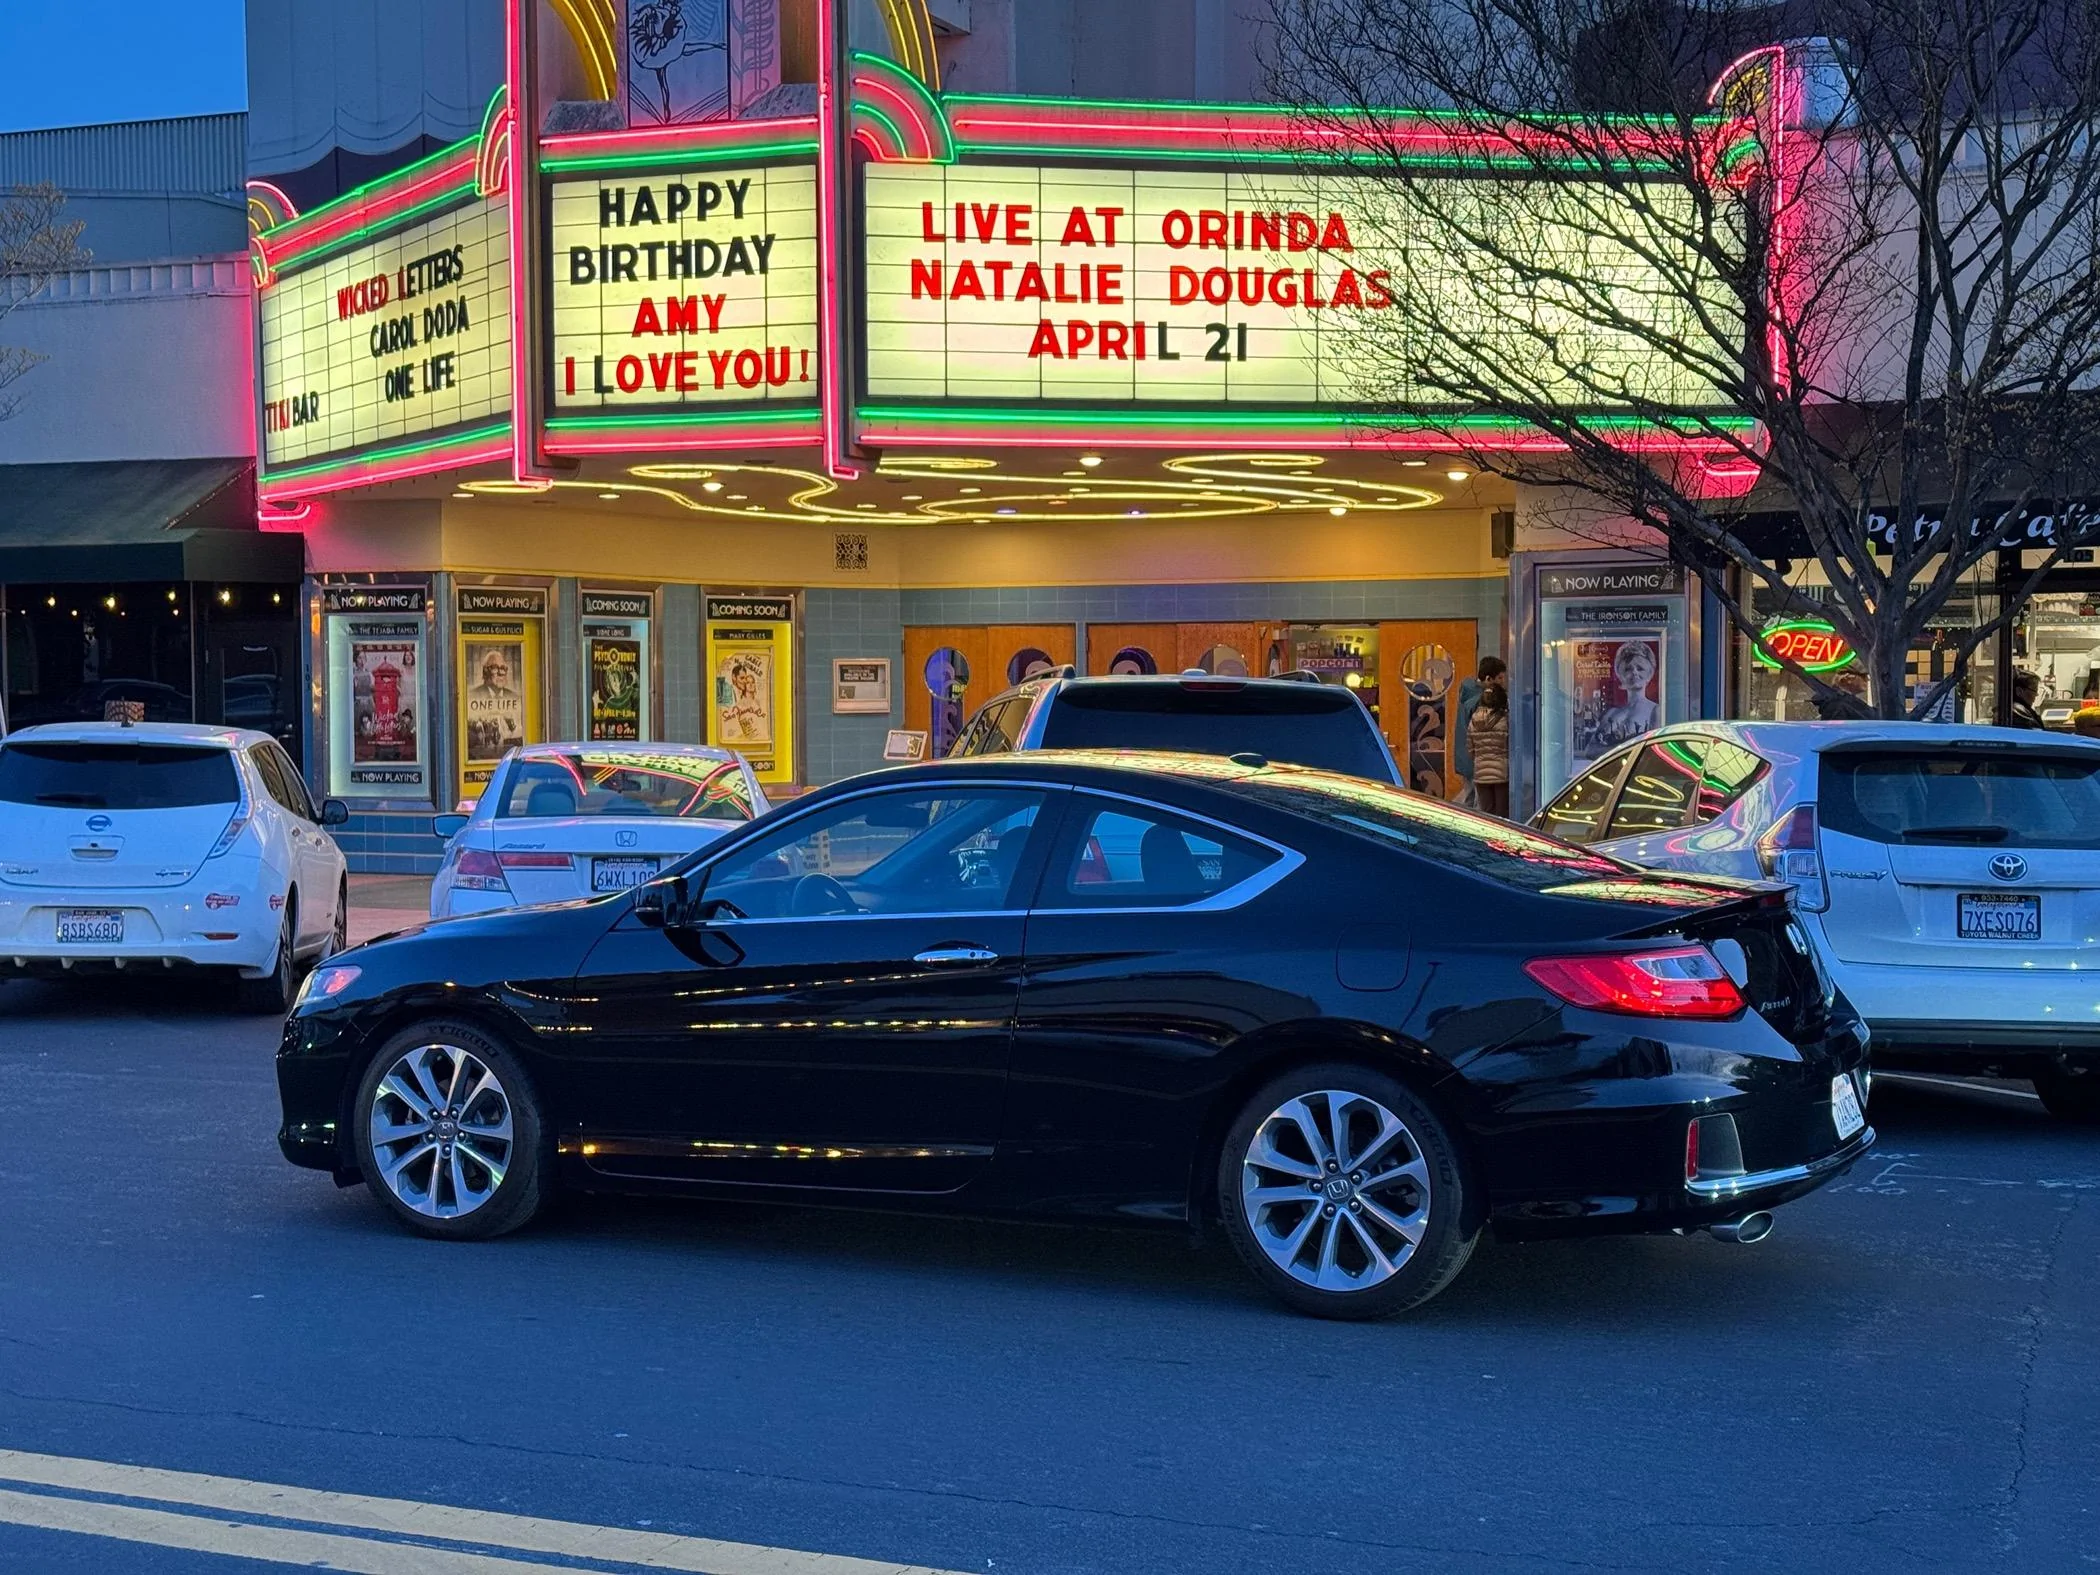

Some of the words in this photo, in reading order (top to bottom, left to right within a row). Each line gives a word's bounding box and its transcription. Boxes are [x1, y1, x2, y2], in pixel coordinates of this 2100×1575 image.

[600, 178, 751, 228] HAPPY
[922, 202, 1033, 245] LIVE
[1060, 207, 1124, 248] AT
[1162, 209, 1354, 253] ORINDA
[570, 234, 776, 285] BIRTHDAY
[337, 273, 390, 321] WICKED
[398, 244, 464, 300] LETTERS
[911, 259, 1124, 304] NATALIE
[1170, 264, 1393, 309] DOUGLAS
[370, 312, 417, 357] CAROL
[423, 295, 470, 343] DODA
[632, 294, 727, 337] AMY
[1028, 318, 1180, 361] APRIL
[1204, 322, 1247, 361] 21
[385, 362, 415, 403] ONE
[423, 351, 455, 394] LIFE
[565, 357, 575, 395] I
[594, 351, 699, 394] LOVE
[266, 397, 290, 433] TIKI
[292, 391, 319, 427] BAR
[1565, 576, 1600, 590] NOW
[1603, 574, 1659, 588] PLAYING
[341, 596, 367, 607] NOW
[368, 595, 408, 607] PLAYING
[473, 596, 494, 608] NOW
[496, 597, 530, 609] PLAYING
[592, 599, 619, 612] COMING
[620, 600, 640, 612] SOON
[720, 605, 752, 615] COMING
[754, 605, 778, 615] SOON
[1581, 612, 1597, 620] THE
[1638, 610, 1667, 619] FAMILY
[1766, 632, 1844, 662] OPEN
[1301, 660, 1360, 669] POPCORN
[470, 700, 493, 710] ONE
[497, 699, 517, 710] LIFE
[362, 772, 384, 782] NOW
[385, 772, 419, 782] PLAYING
[63, 922, 119, 938] 8SBS680
[1964, 911, 2035, 932] 7XES076
[1988, 931, 2016, 939] WALNUT
